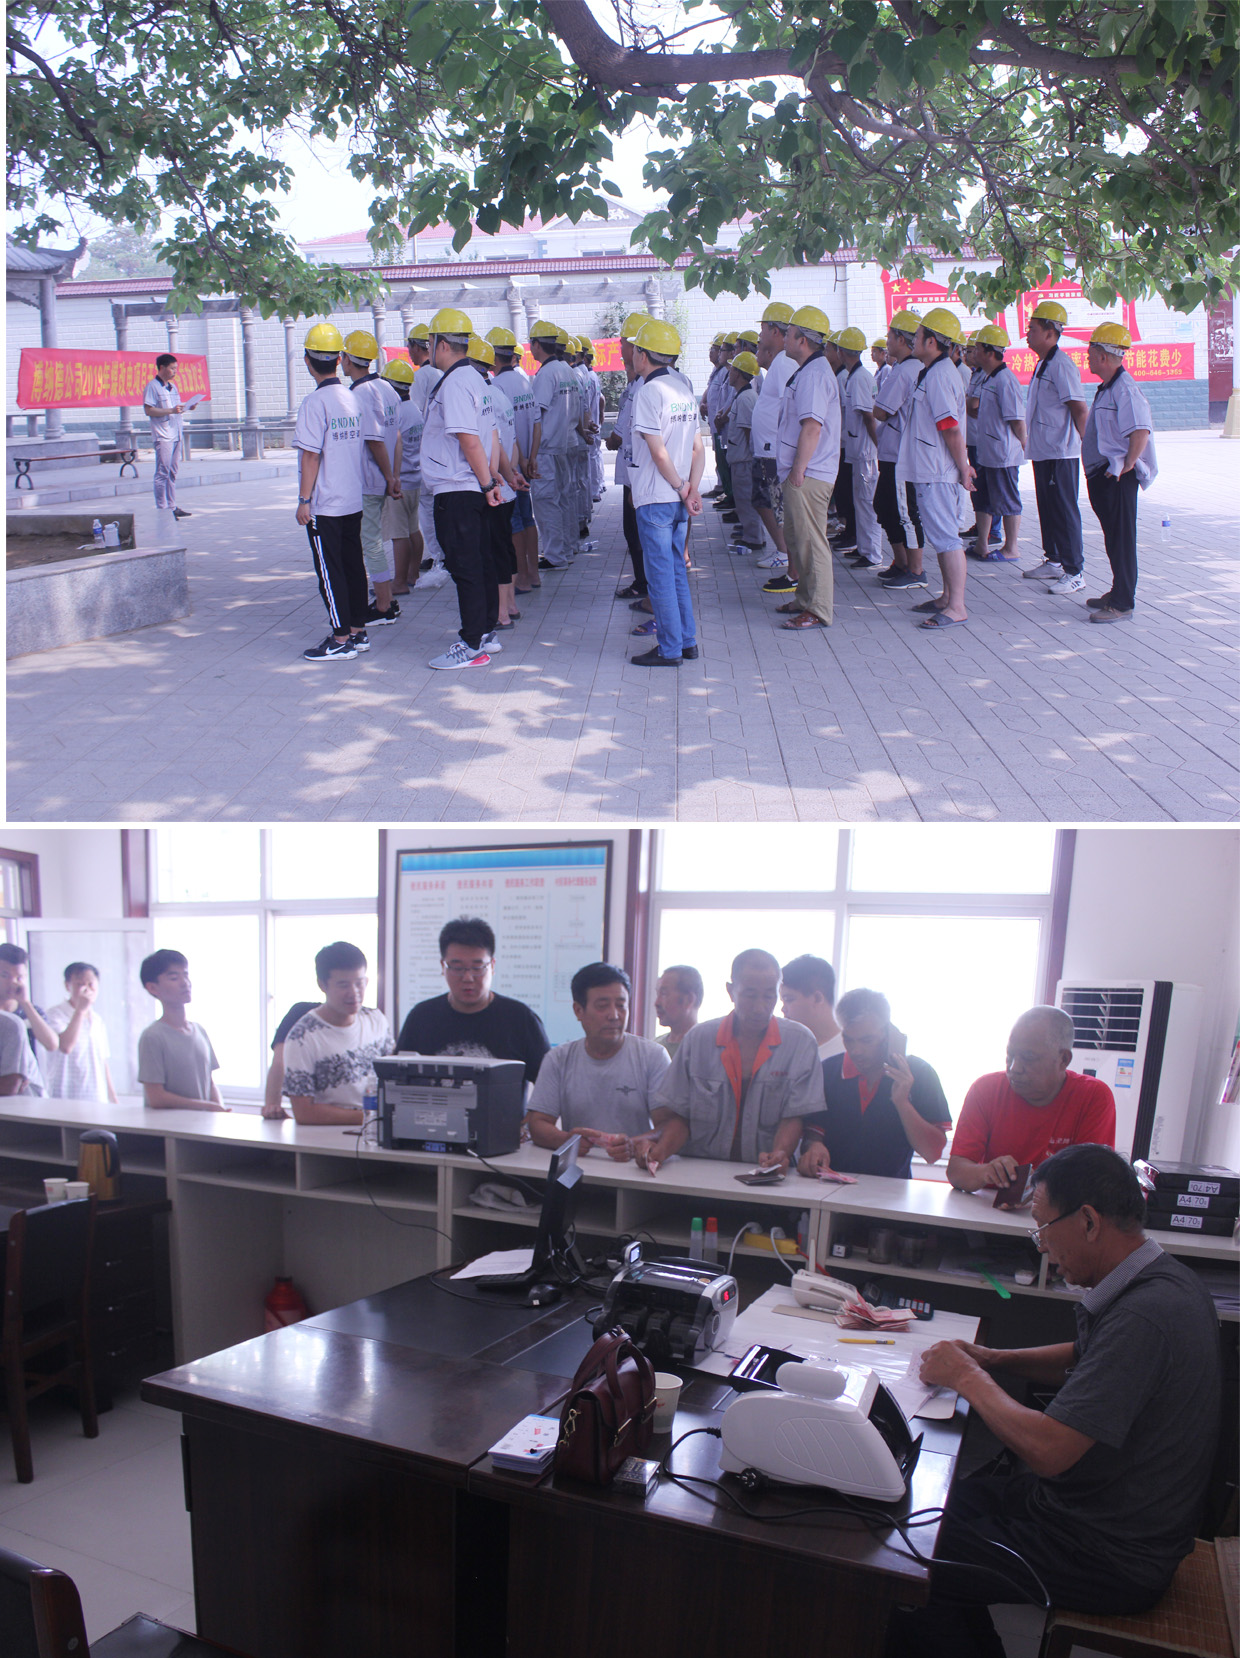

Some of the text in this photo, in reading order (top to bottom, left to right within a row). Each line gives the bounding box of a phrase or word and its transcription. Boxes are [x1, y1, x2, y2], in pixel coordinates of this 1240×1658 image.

[1125, 349, 1182, 369] 节能花费少
[1179, 1195, 1192, 1204] A4
[1172, 1215, 1185, 1224] A4
